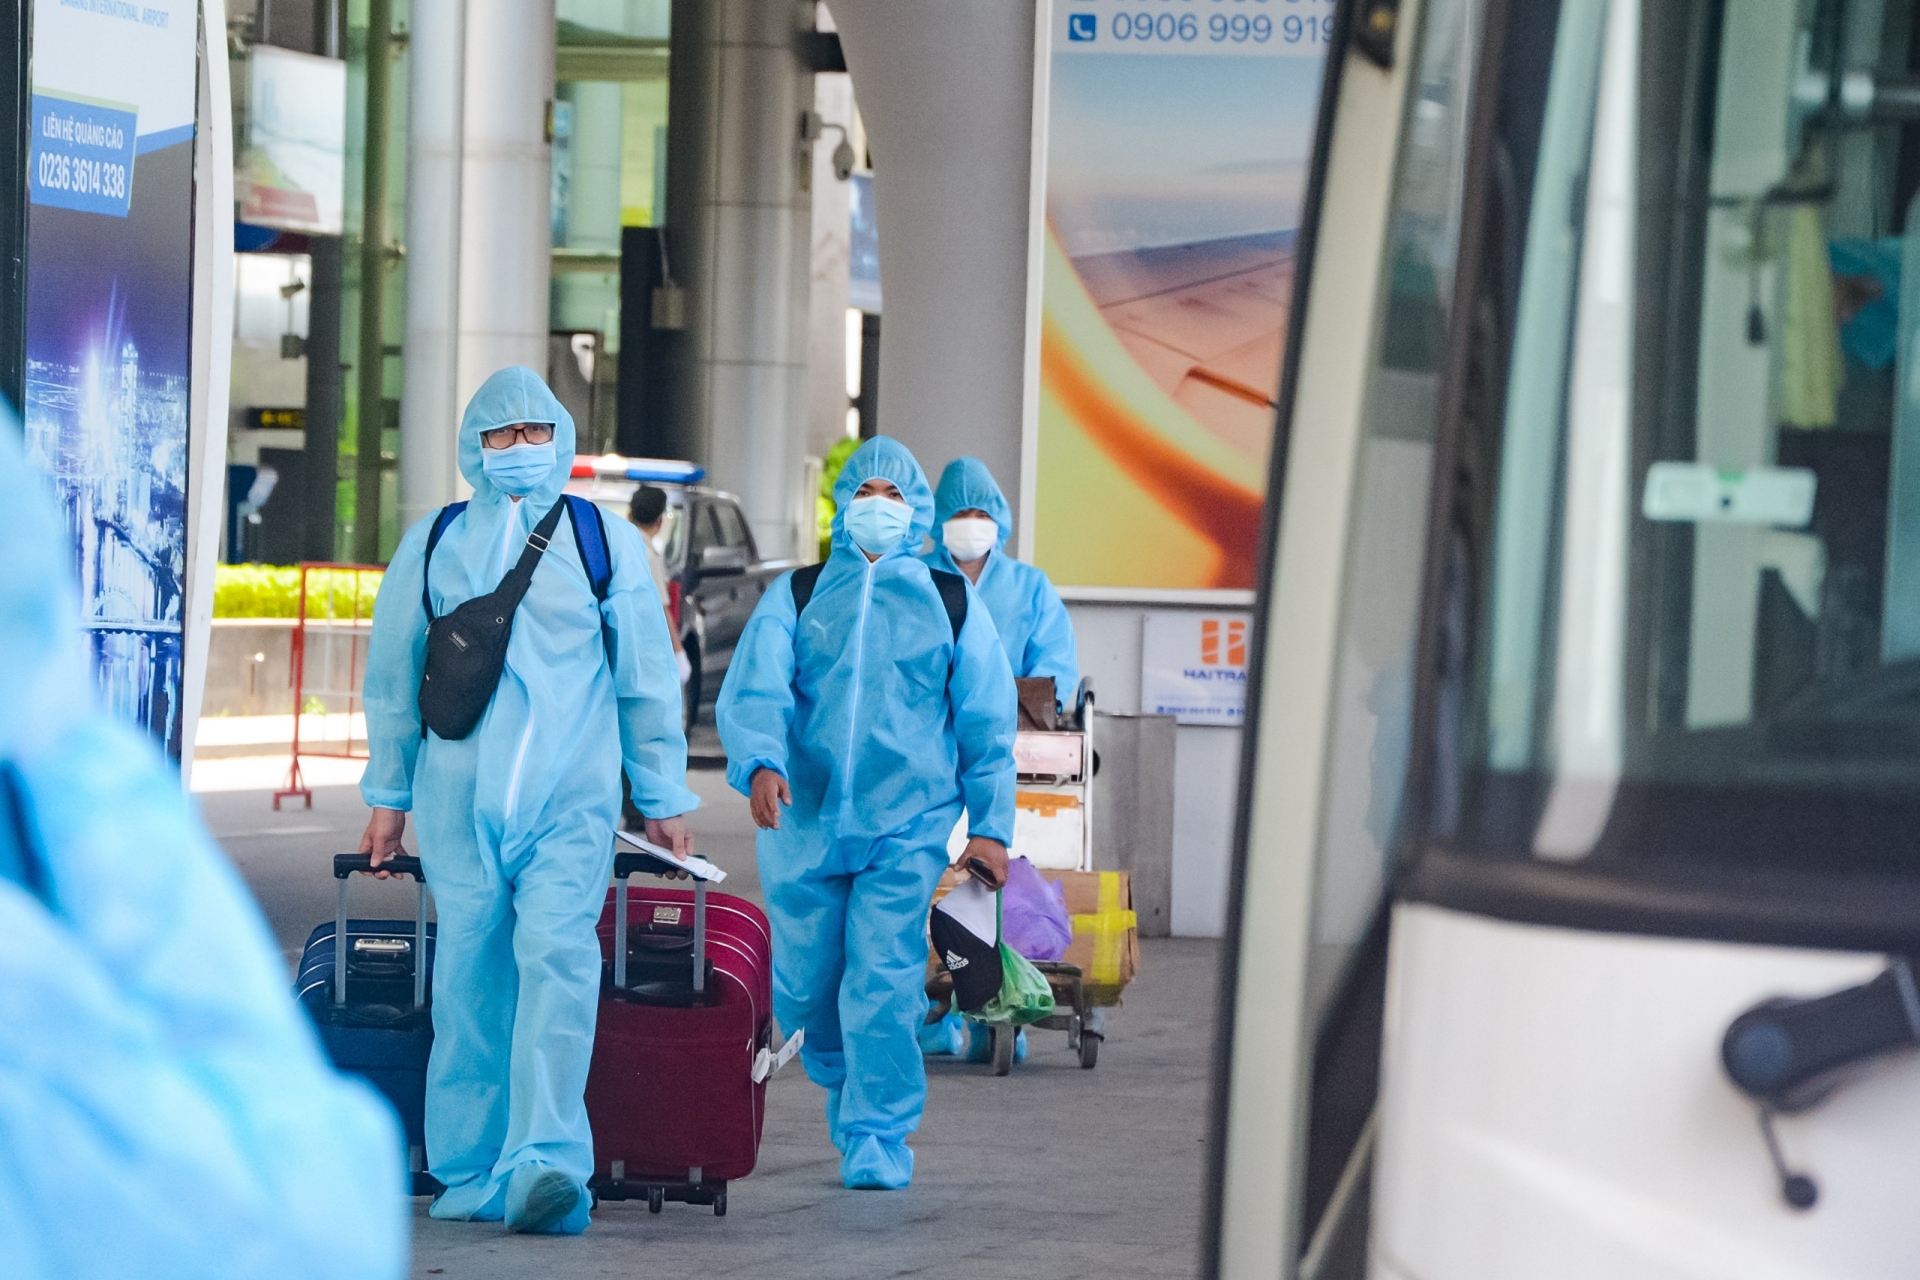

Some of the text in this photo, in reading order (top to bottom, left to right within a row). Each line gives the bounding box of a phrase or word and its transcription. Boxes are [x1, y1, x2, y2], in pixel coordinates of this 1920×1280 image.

[141, 7, 169, 29] AIRPORT
[1111, 12, 1198, 42] 0906
[1208, 13, 1272, 43] 999
[43, 112, 123, 150] LIÊN HỆ QUẢNG CÁO
[39, 152, 125, 199] 0236 3614 338
